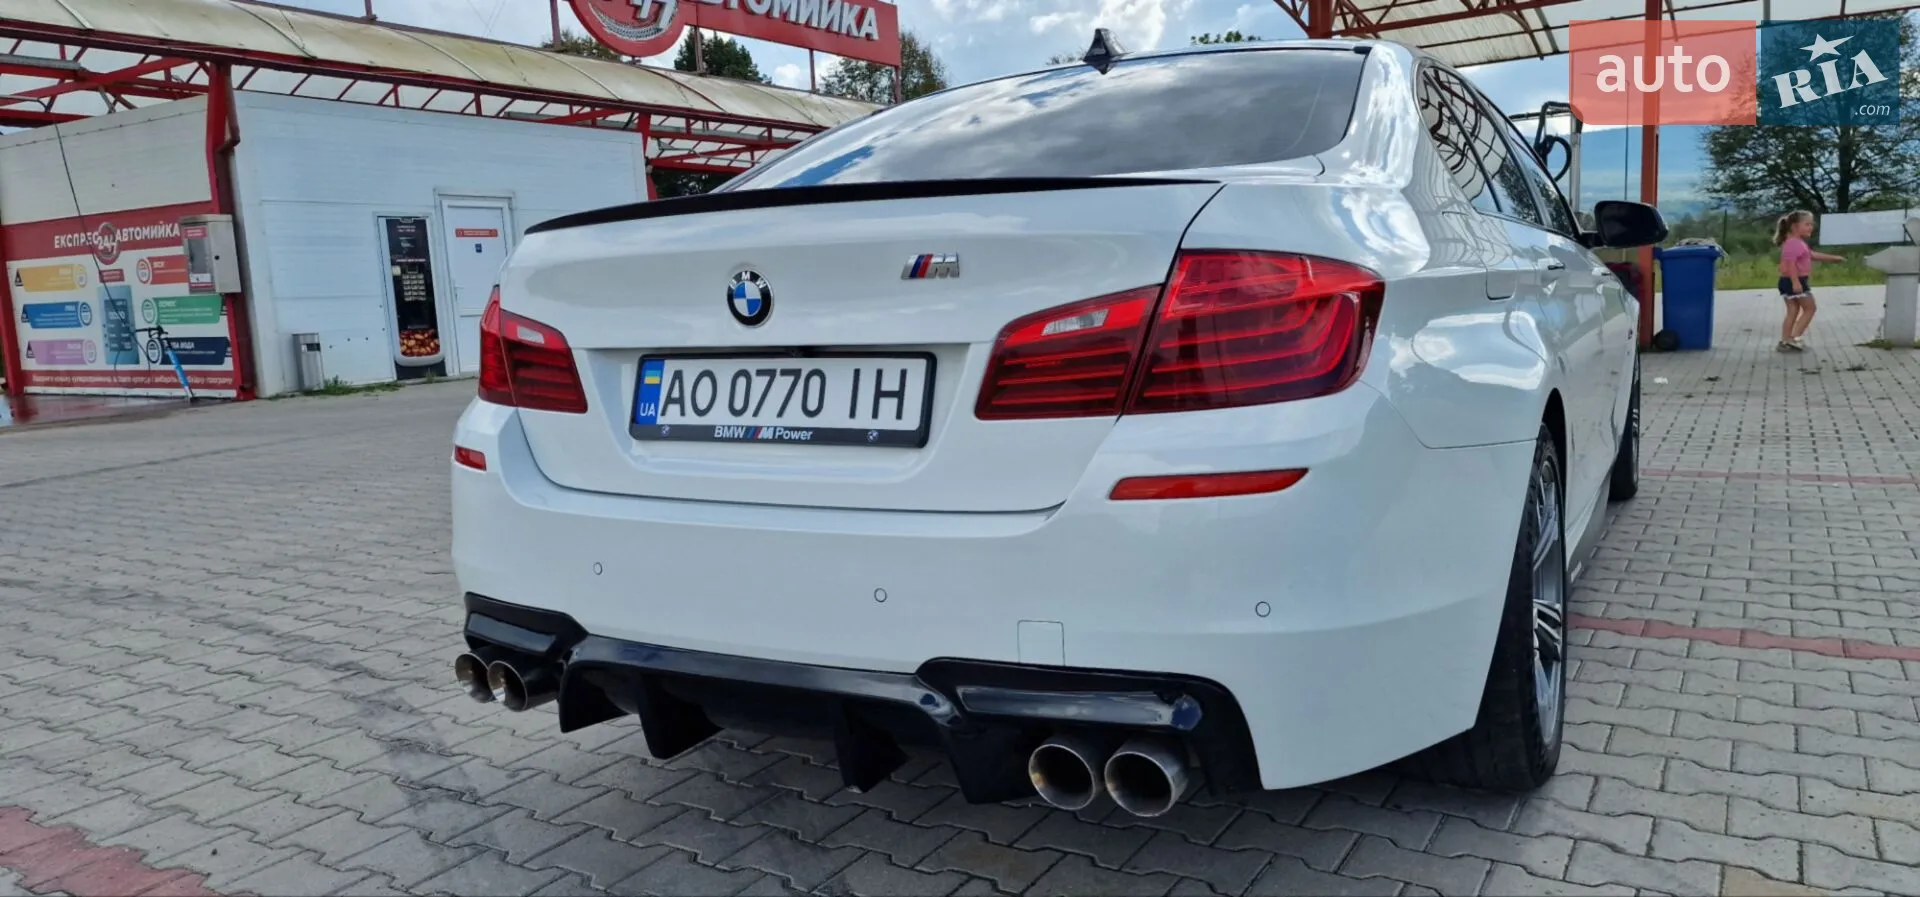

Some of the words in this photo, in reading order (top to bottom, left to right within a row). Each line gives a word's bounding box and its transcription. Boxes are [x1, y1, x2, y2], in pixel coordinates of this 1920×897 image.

[54, 231, 99, 249] ЕКСПРЕС
[115, 220, 180, 242] АВТОМИЙКА
[728, 270, 768, 290] BMW
[660, 369, 718, 418] AO
[728, 368, 827, 419] 0770
[848, 367, 908, 421] IH
[639, 402, 656, 418] UA
[713, 425, 746, 439] BMW
[774, 427, 813, 441] Power
